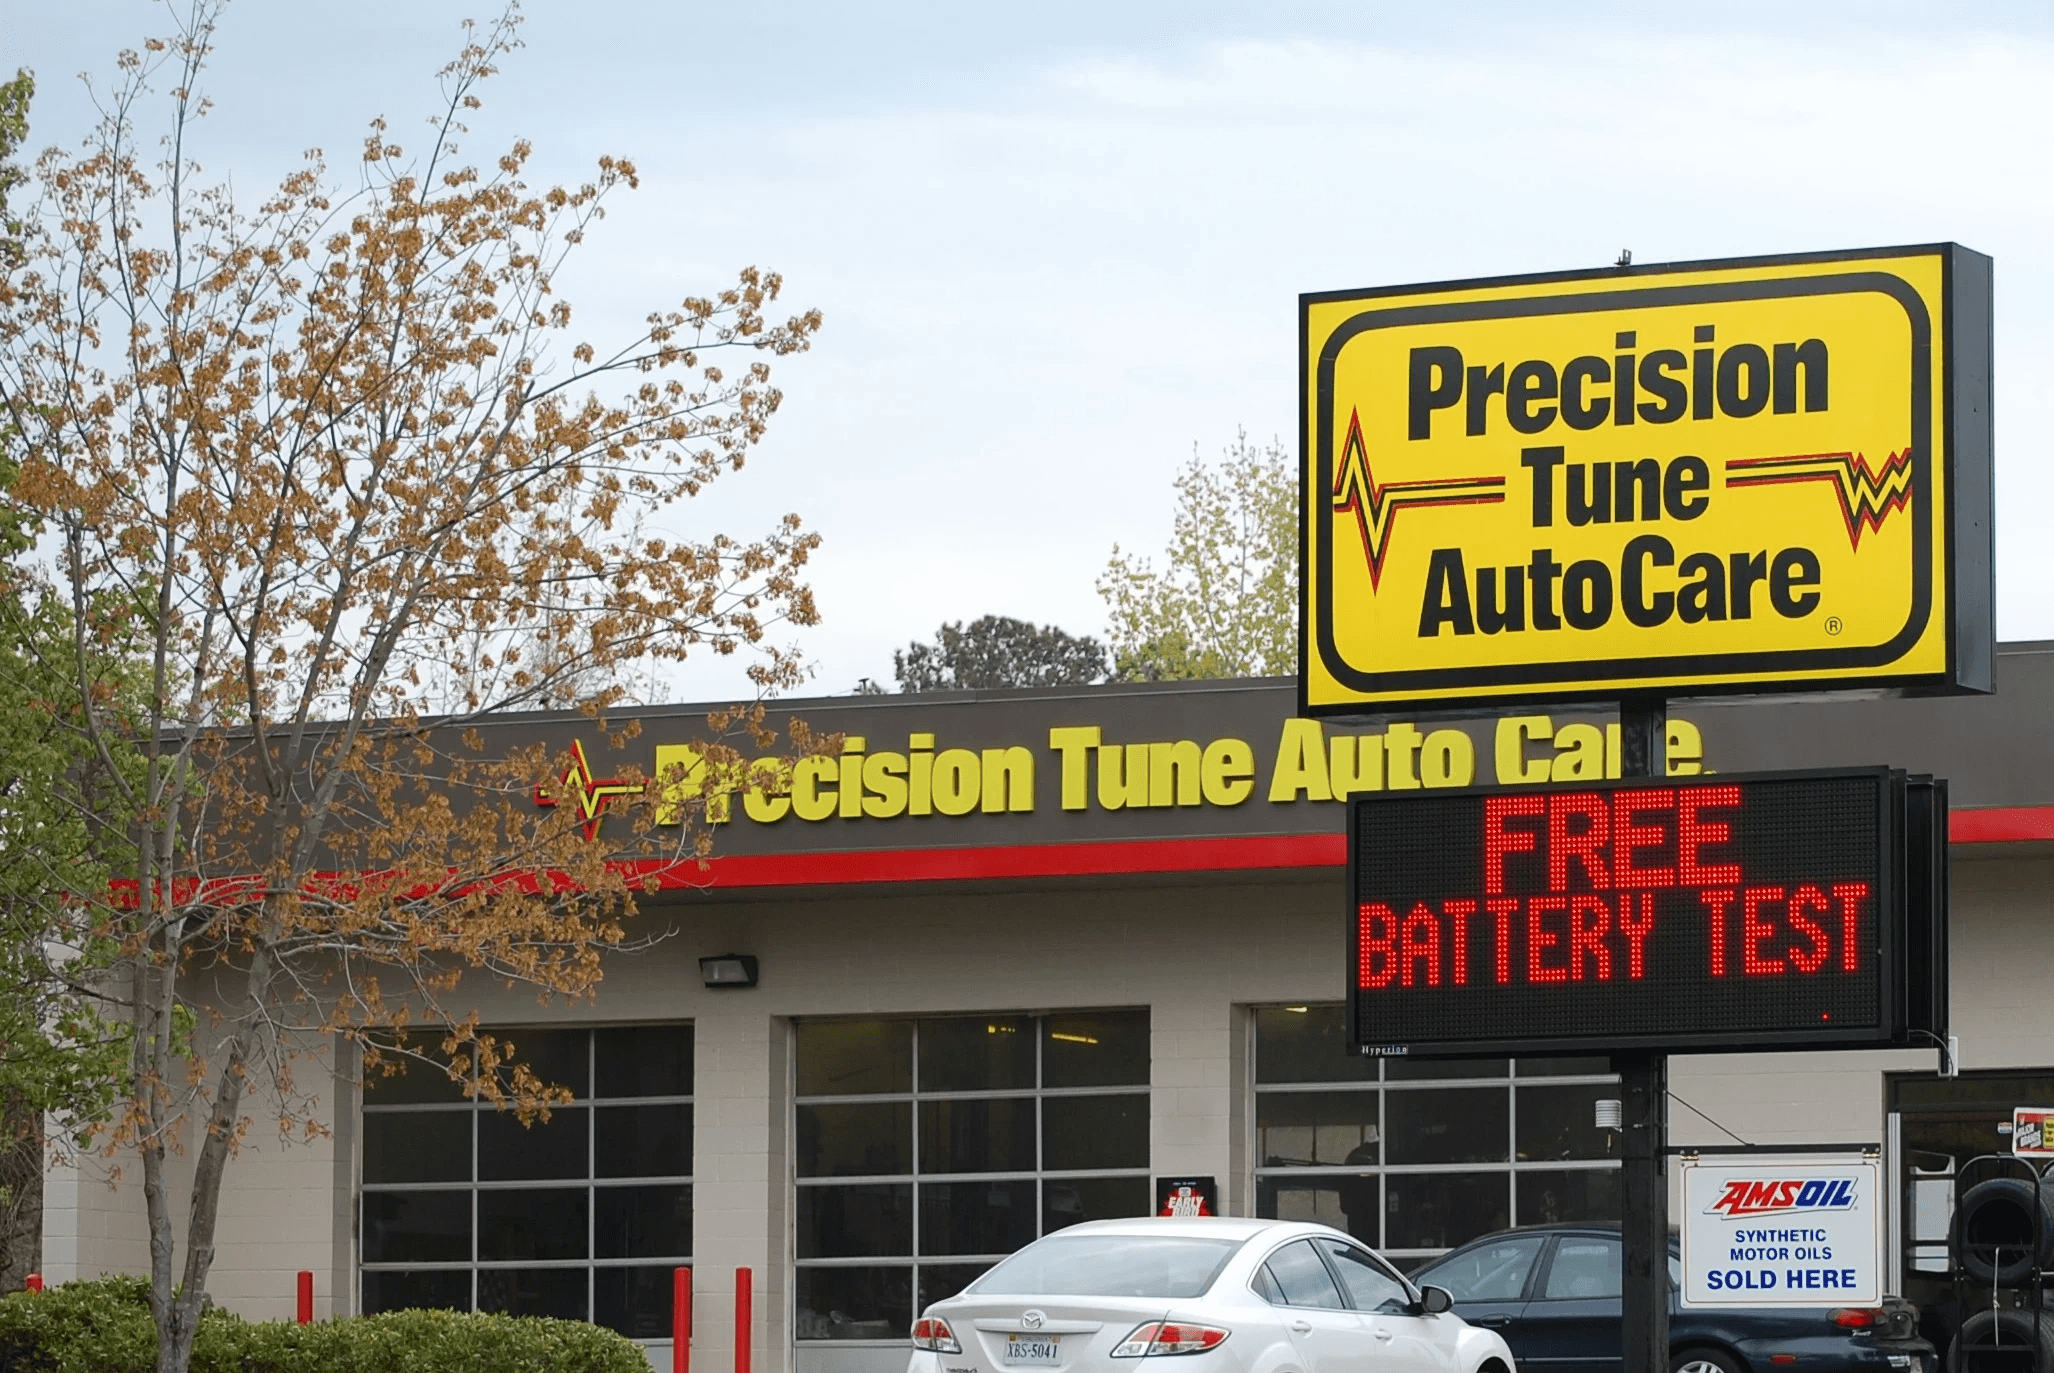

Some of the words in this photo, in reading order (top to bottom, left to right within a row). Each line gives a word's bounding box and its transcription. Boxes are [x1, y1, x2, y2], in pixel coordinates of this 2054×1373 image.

[1408, 325, 1829, 441] Precision
[1521, 446, 1710, 528] Tune
[655, 732, 1034, 826] Precision
[1049, 726, 1255, 811] Tune
[1267, 717, 1475, 802] Auto
[1485, 786, 1741, 893] FREE
[1359, 893, 1654, 989] BATTERY
[1701, 883, 1868, 977] TEST
[1168, 1196, 1204, 1210] EARLY
[1713, 1180, 1852, 1215] AMSOIL
[1735, 1229, 1826, 1243] SYNTHETIC
[1730, 1247, 1789, 1261] MOTOR
[1795, 1247, 1832, 1260] OILS
[1707, 1270, 1777, 1290] SOLD
[1786, 1269, 1857, 1288] HERE
[1008, 1343, 1058, 1358] XBS-5041
